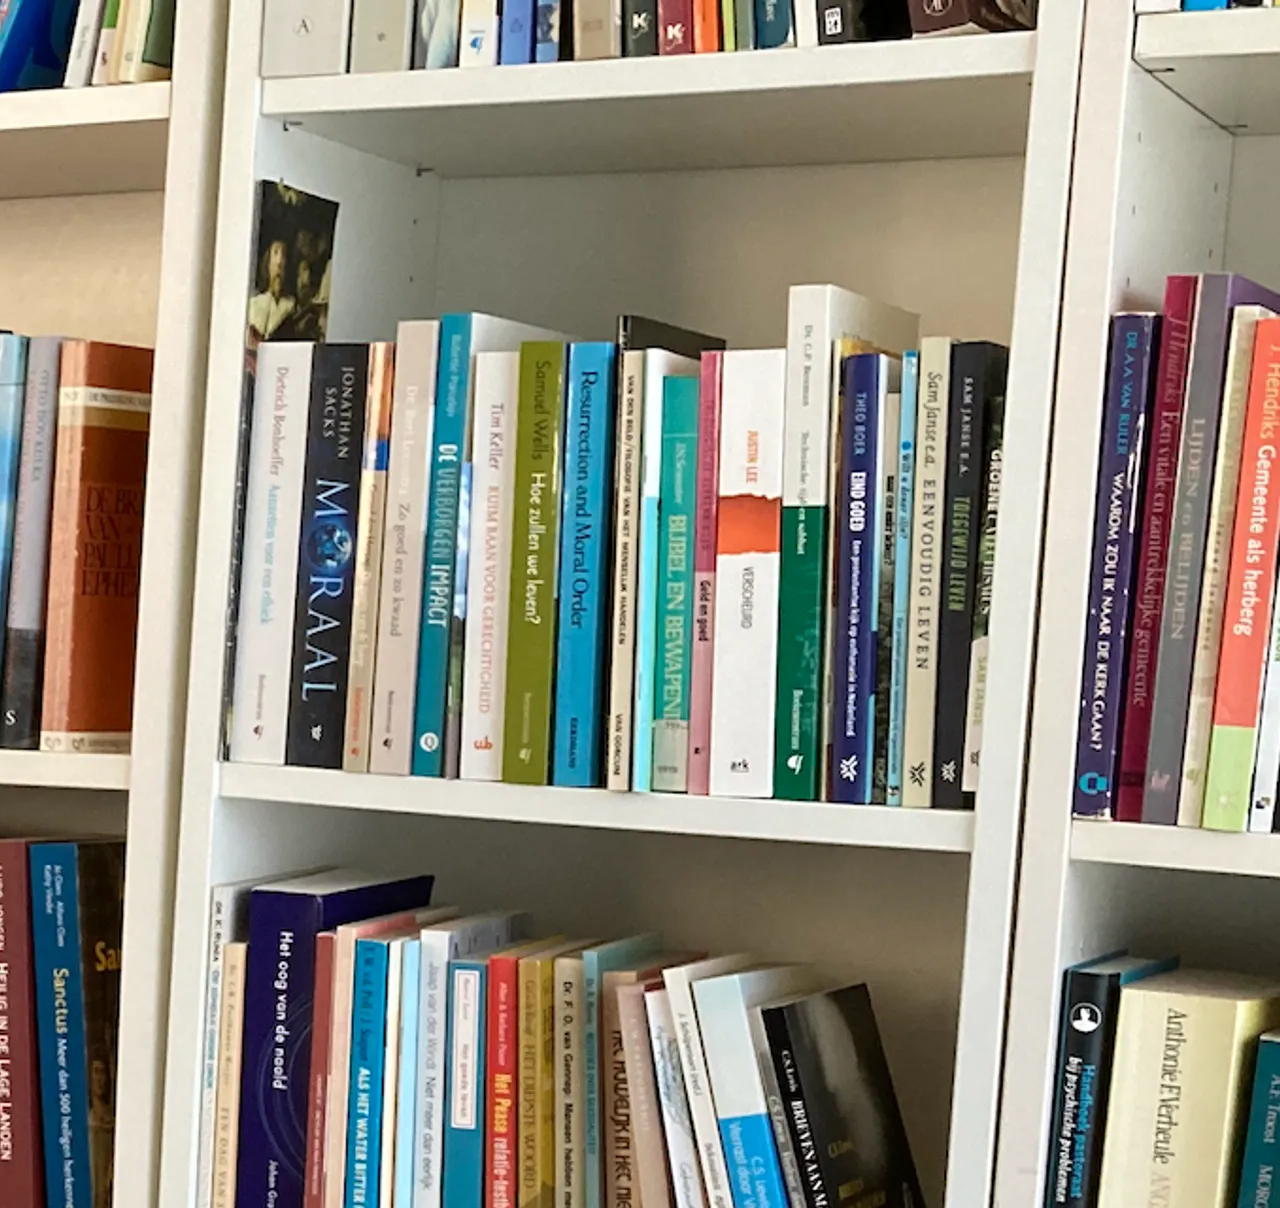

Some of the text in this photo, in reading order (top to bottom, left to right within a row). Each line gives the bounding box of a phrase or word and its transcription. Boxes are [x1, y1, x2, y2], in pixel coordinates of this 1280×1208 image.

[322, 387, 337, 438] SACKS
[337, 367, 355, 459] JONATHAN
[488, 402, 504, 471] Tim Keller
[569, 371, 599, 629] Resurrection and Moral Order
[849, 472, 866, 531] EIND GOED
[426, 444, 458, 628] DE VERBORGEN IMPACT
[523, 473, 547, 624] Hoe zullen we leven?
[1234, 444, 1275, 636] Gemeente als herberg
[478, 486, 500, 714] RUIM BAAN VOOR GERECHTIGHEID
[740, 567, 754, 629] VERSCHEURD
[916, 479, 937, 670] EENVOUDIG LEVEN
[1090, 473, 1125, 750] WAAROM ZOU IK NAAR DE KERK GAAN?
[52, 968, 71, 1034] Sanctus
[271, 931, 294, 1090] Het oog van de naald
[56, 1038, 70, 1066] Meer
[58, 1069, 72, 1090] dan
[356, 1067, 371, 1090] ALS
[58, 1116, 74, 1157] heiligen
[59, 1092, 72, 1113] 500
[356, 1093, 370, 1115] HET
[1054, 1056, 1082, 1202] bij psychische problemen
[1070, 1064, 1096, 1198] Handboek pastoraat
[354, 1118, 370, 1160] WATER
[791, 1100, 816, 1160] BRIEVEN
[805, 1163, 821, 1190] AAN
[352, 1163, 368, 1202] BITTER
